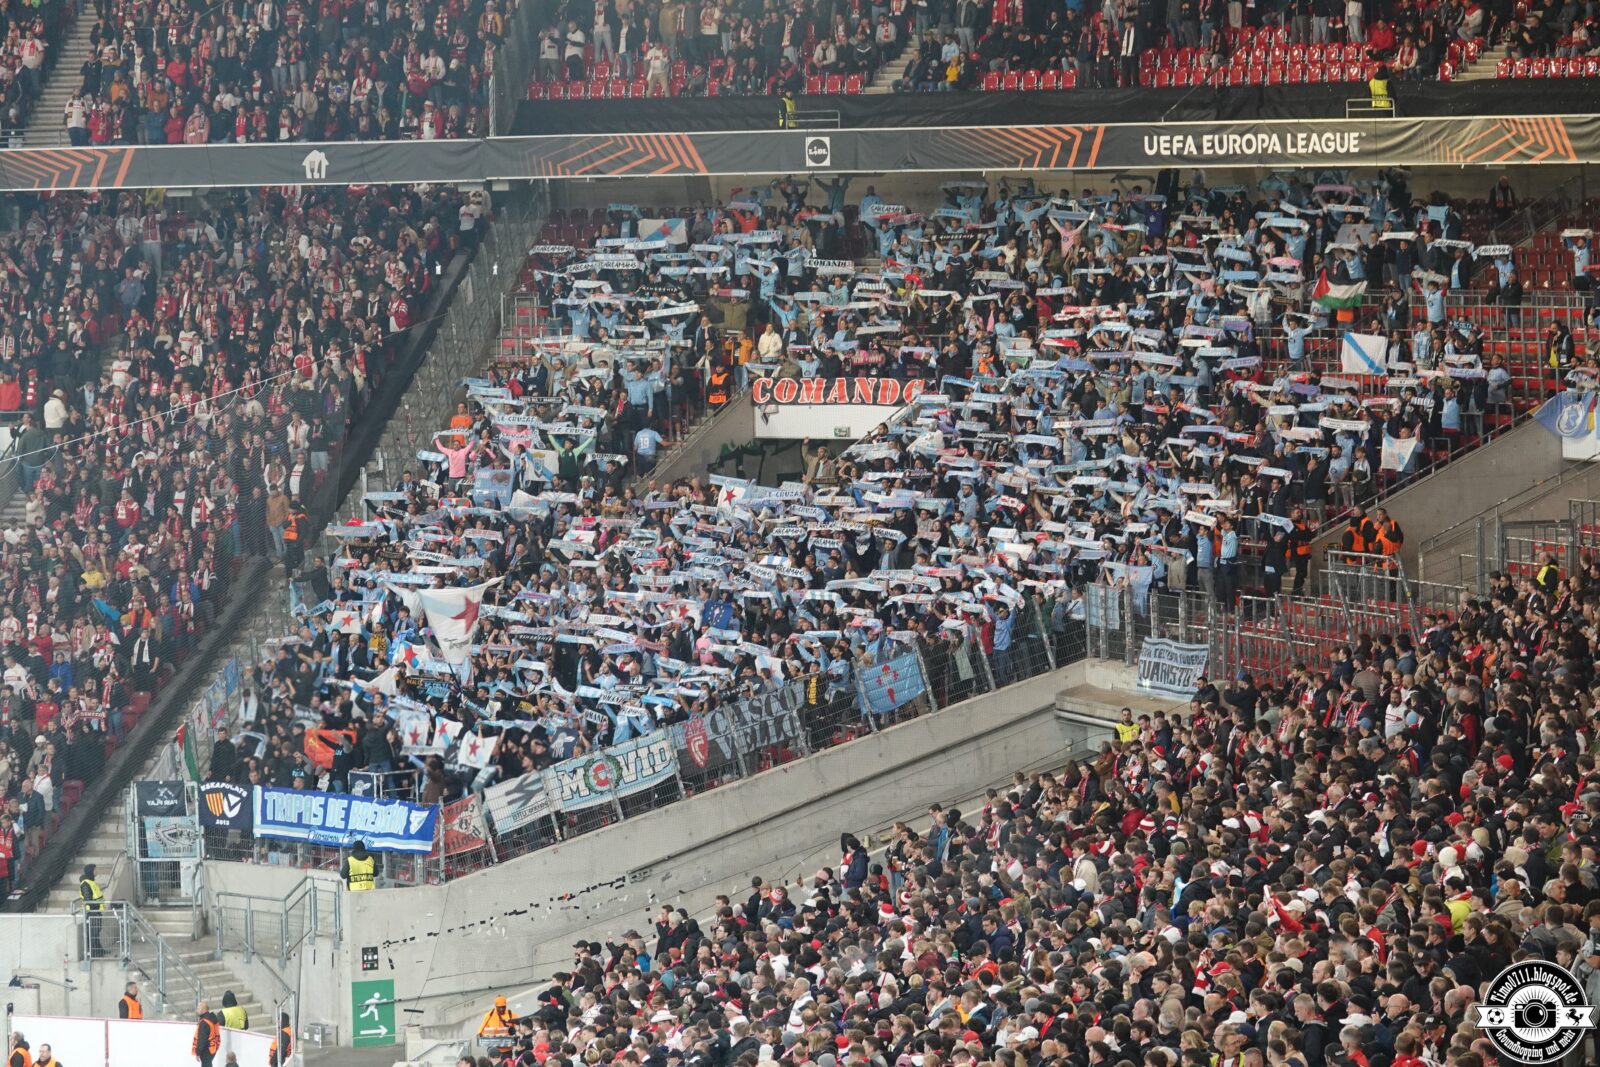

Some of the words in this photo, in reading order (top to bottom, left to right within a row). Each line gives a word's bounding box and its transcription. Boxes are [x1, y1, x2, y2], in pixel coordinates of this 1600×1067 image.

[1144, 135, 1197, 156] UEFA
[1202, 133, 1282, 155] EUROPA
[640, 437, 650, 449] 19
[710, 684, 797, 736] CASCO
[264, 791, 325, 827] TROPAS
[325, 798, 348, 829] DE
